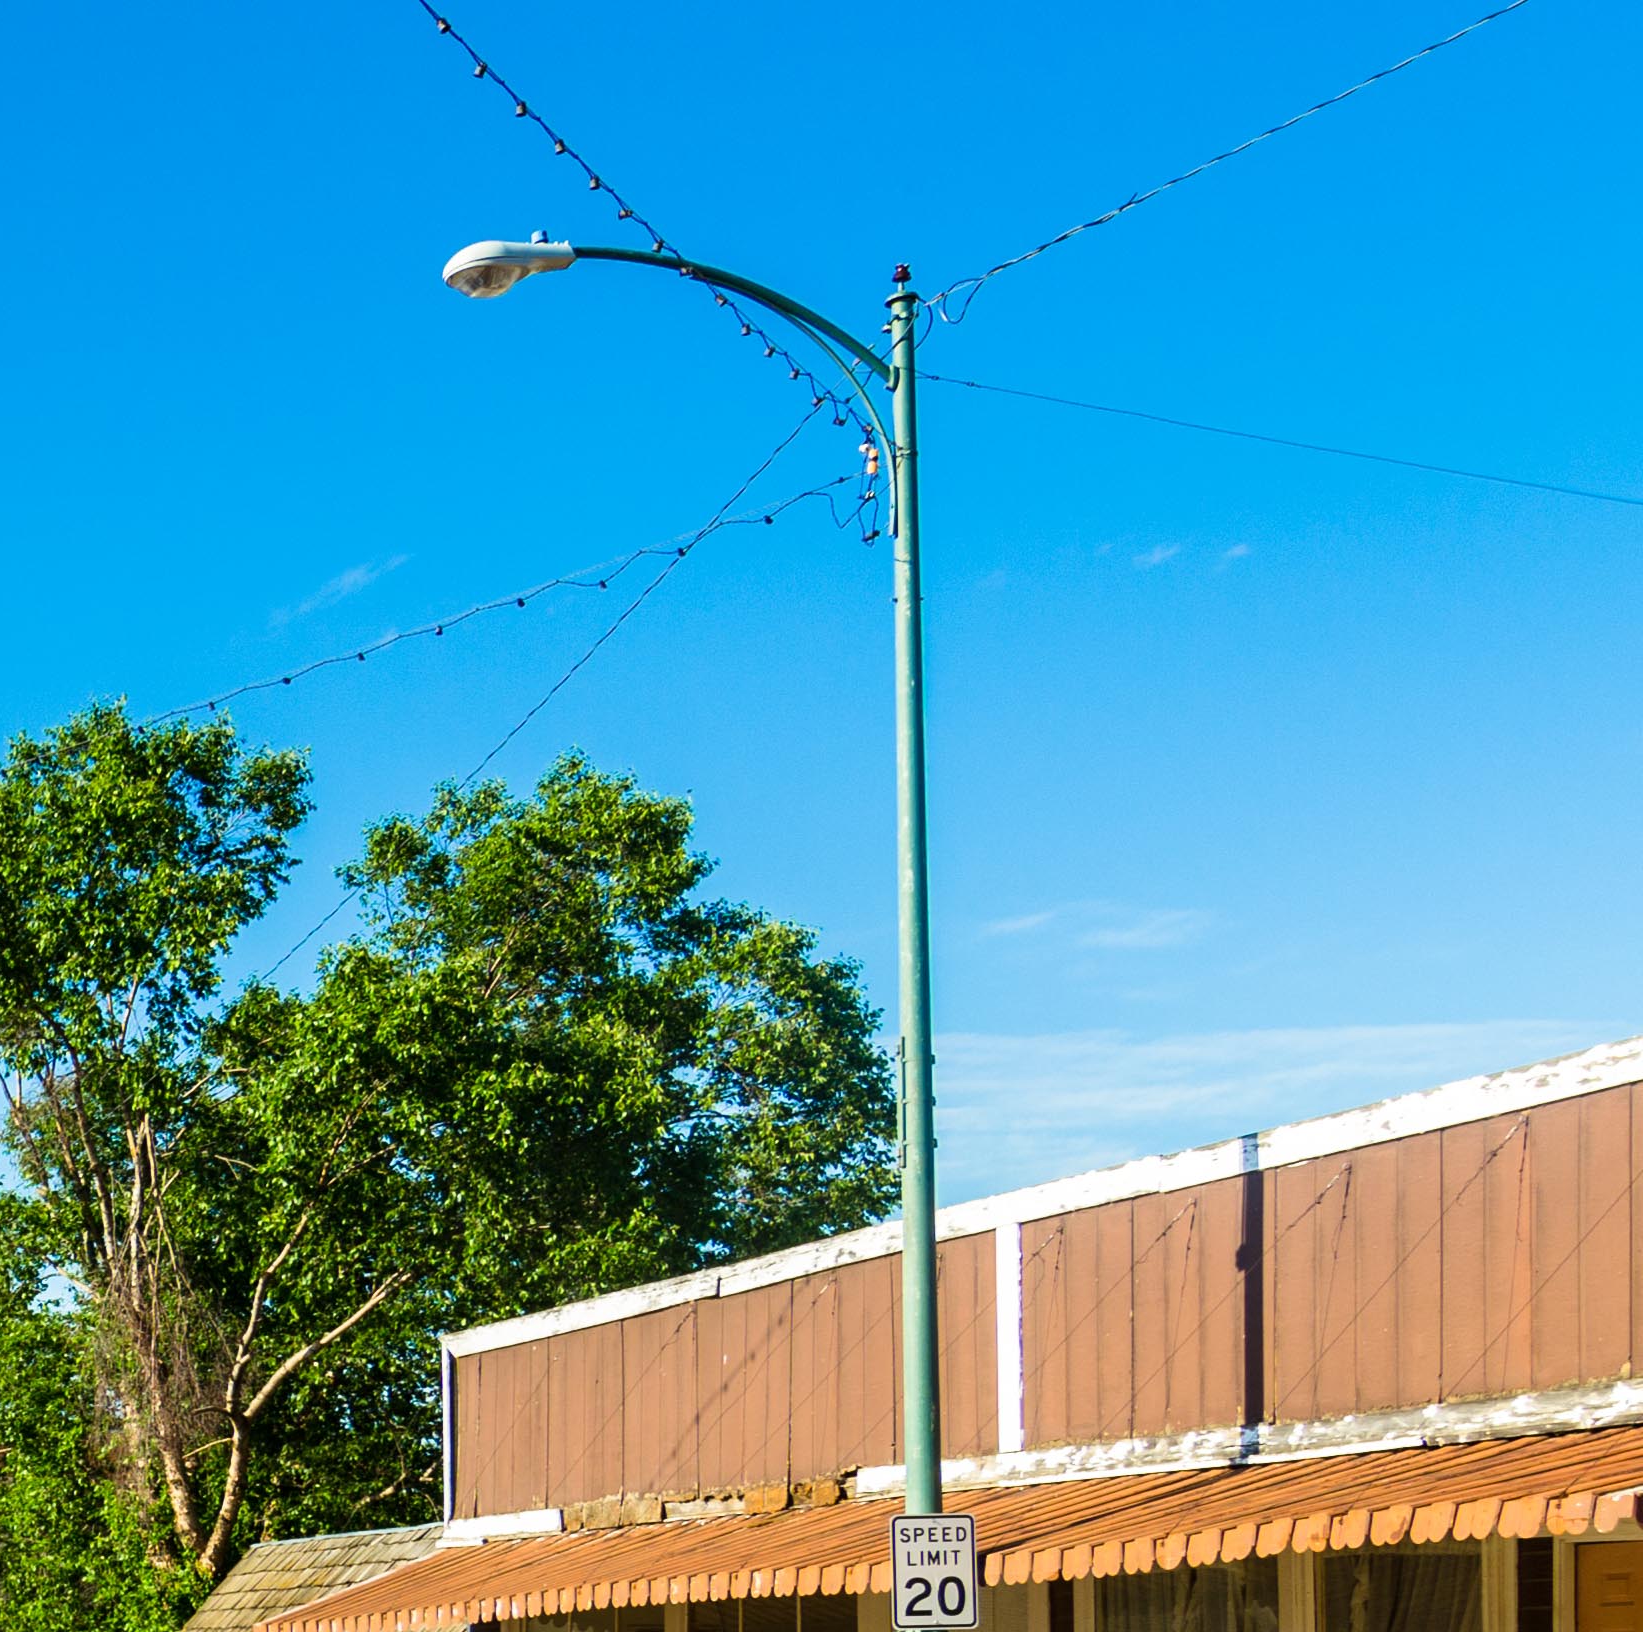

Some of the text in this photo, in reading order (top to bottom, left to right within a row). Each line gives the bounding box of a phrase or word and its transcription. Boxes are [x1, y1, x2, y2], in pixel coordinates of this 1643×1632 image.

[900, 1526, 967, 1543] SPEED
[907, 1550, 961, 1566] LIMIT
[905, 1576, 966, 1617] 20
